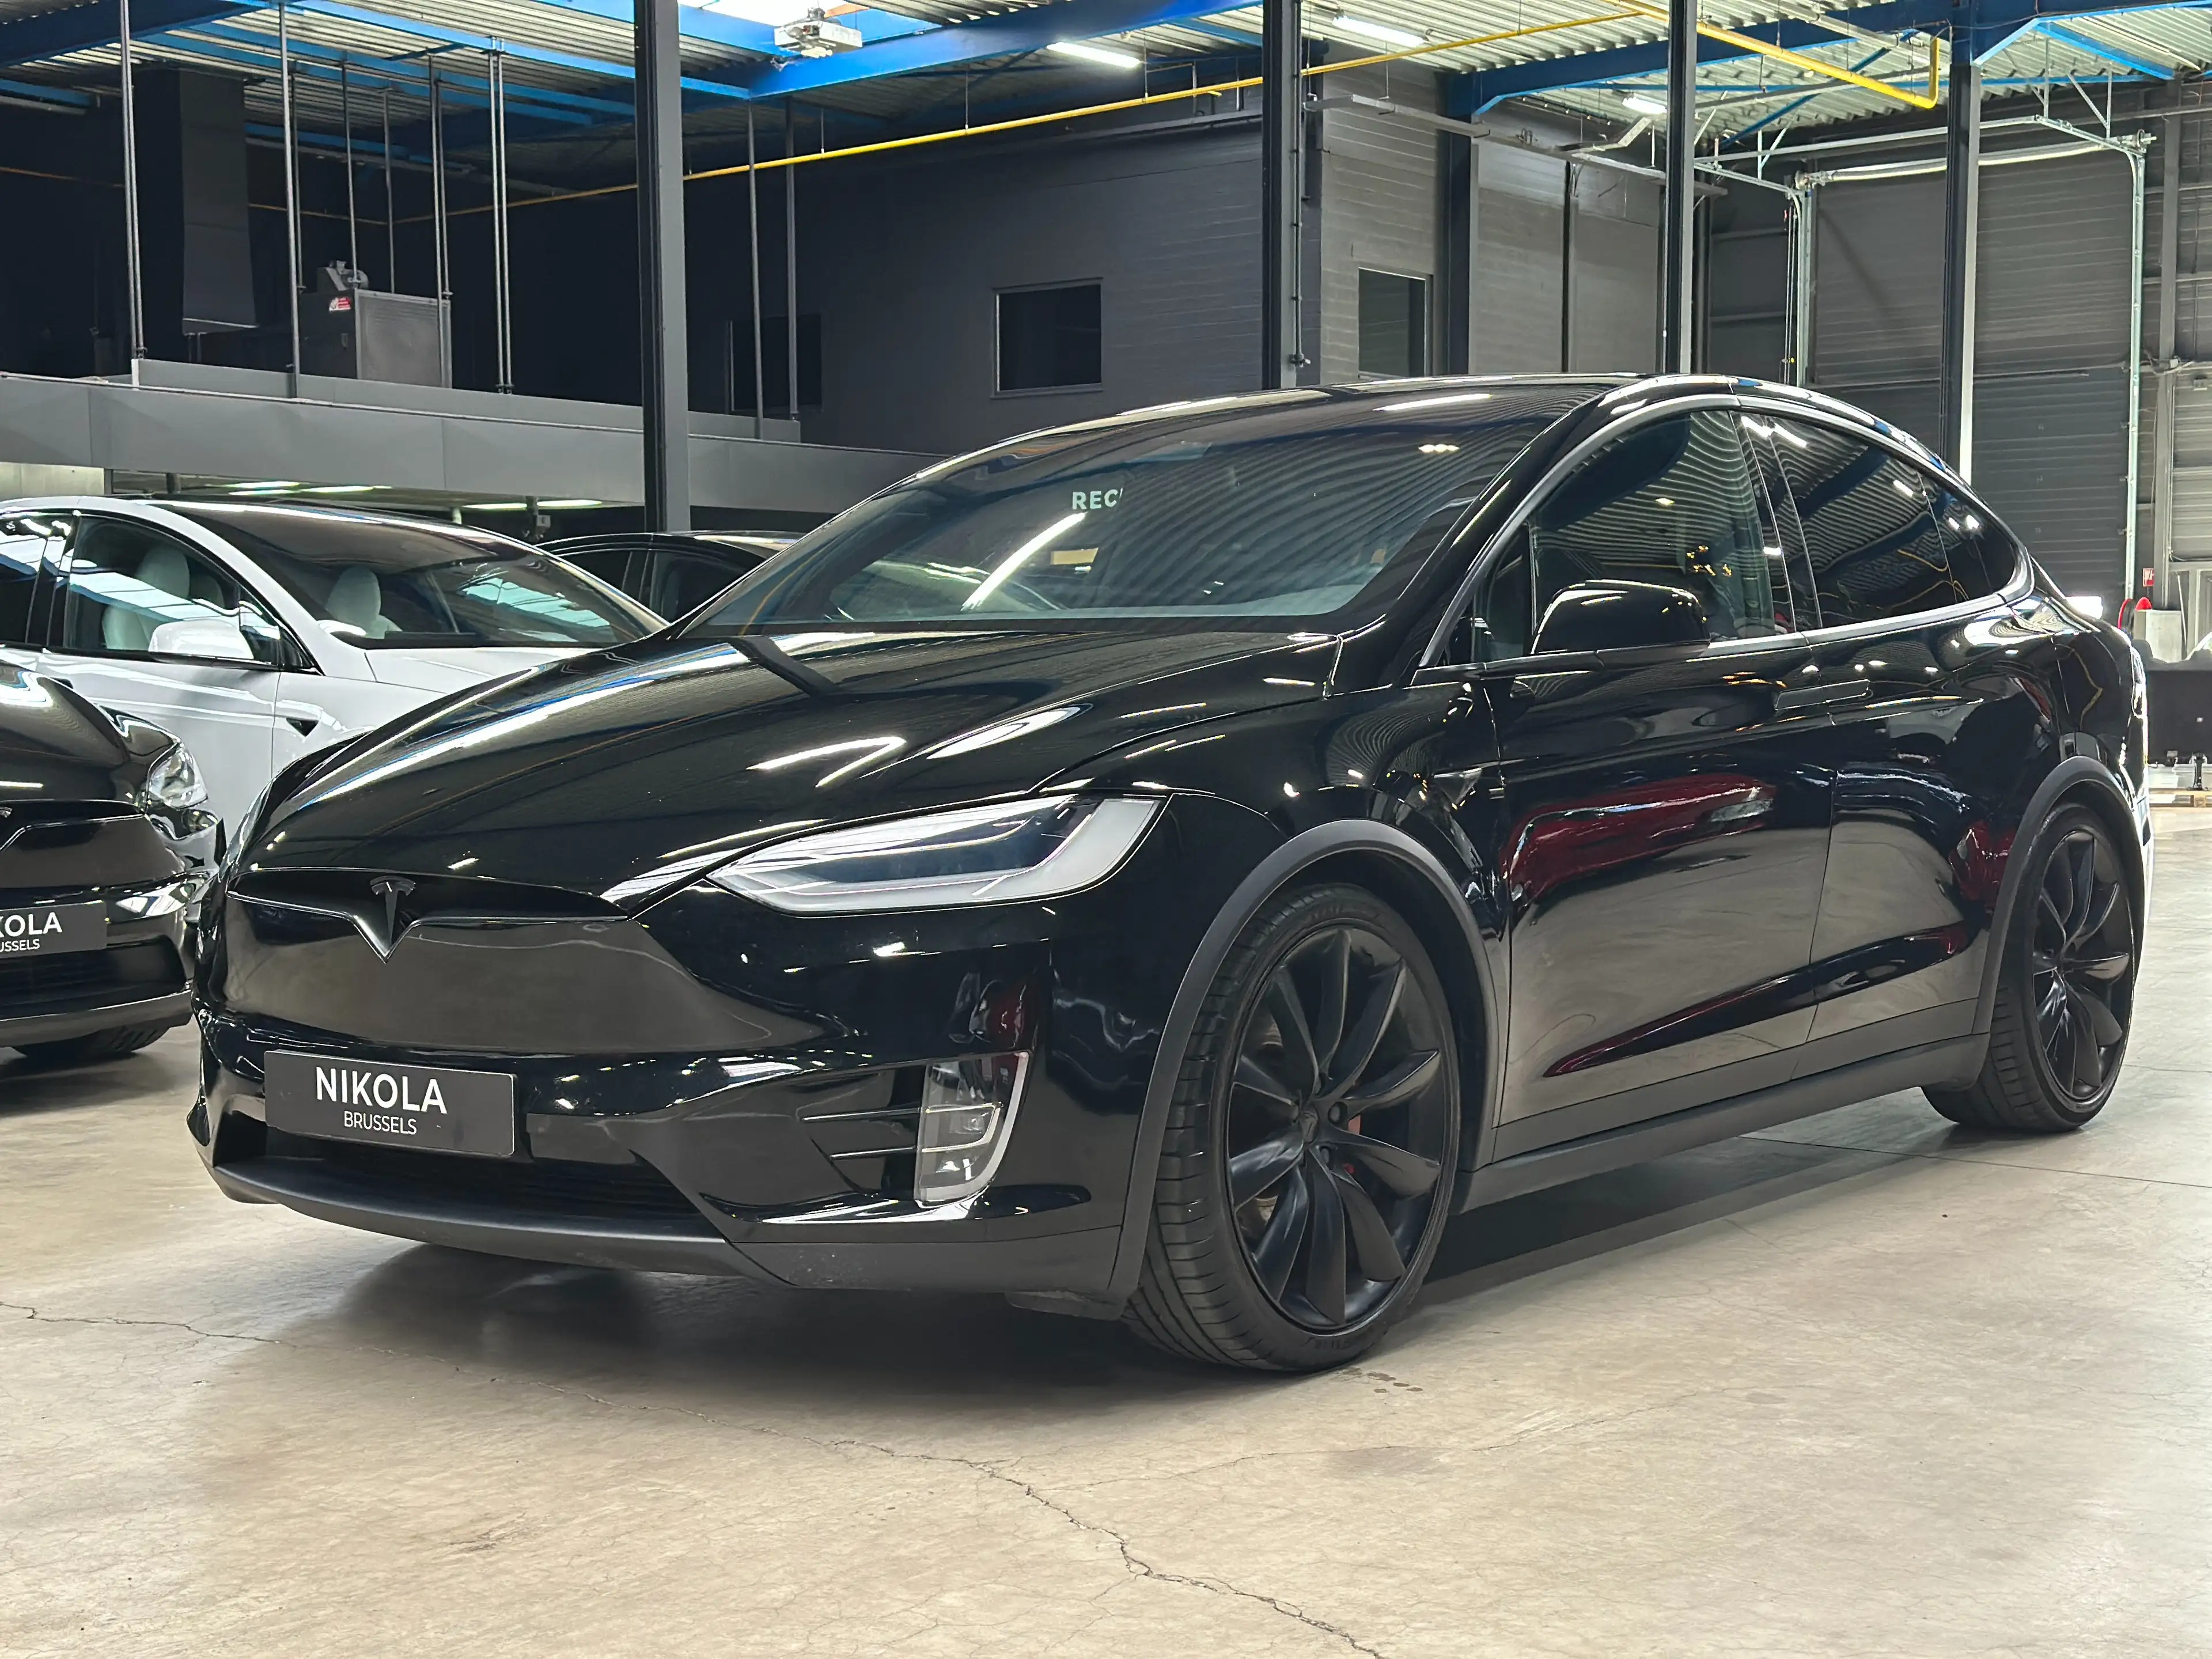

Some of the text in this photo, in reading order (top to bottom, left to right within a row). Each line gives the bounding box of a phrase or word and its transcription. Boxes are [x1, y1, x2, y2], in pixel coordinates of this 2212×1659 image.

[1072, 487, 1123, 510] REC
[0, 912, 63, 938] OLA
[316, 1066, 448, 1114] NIKOLA
[344, 1111, 417, 1135] BRUSSELS
